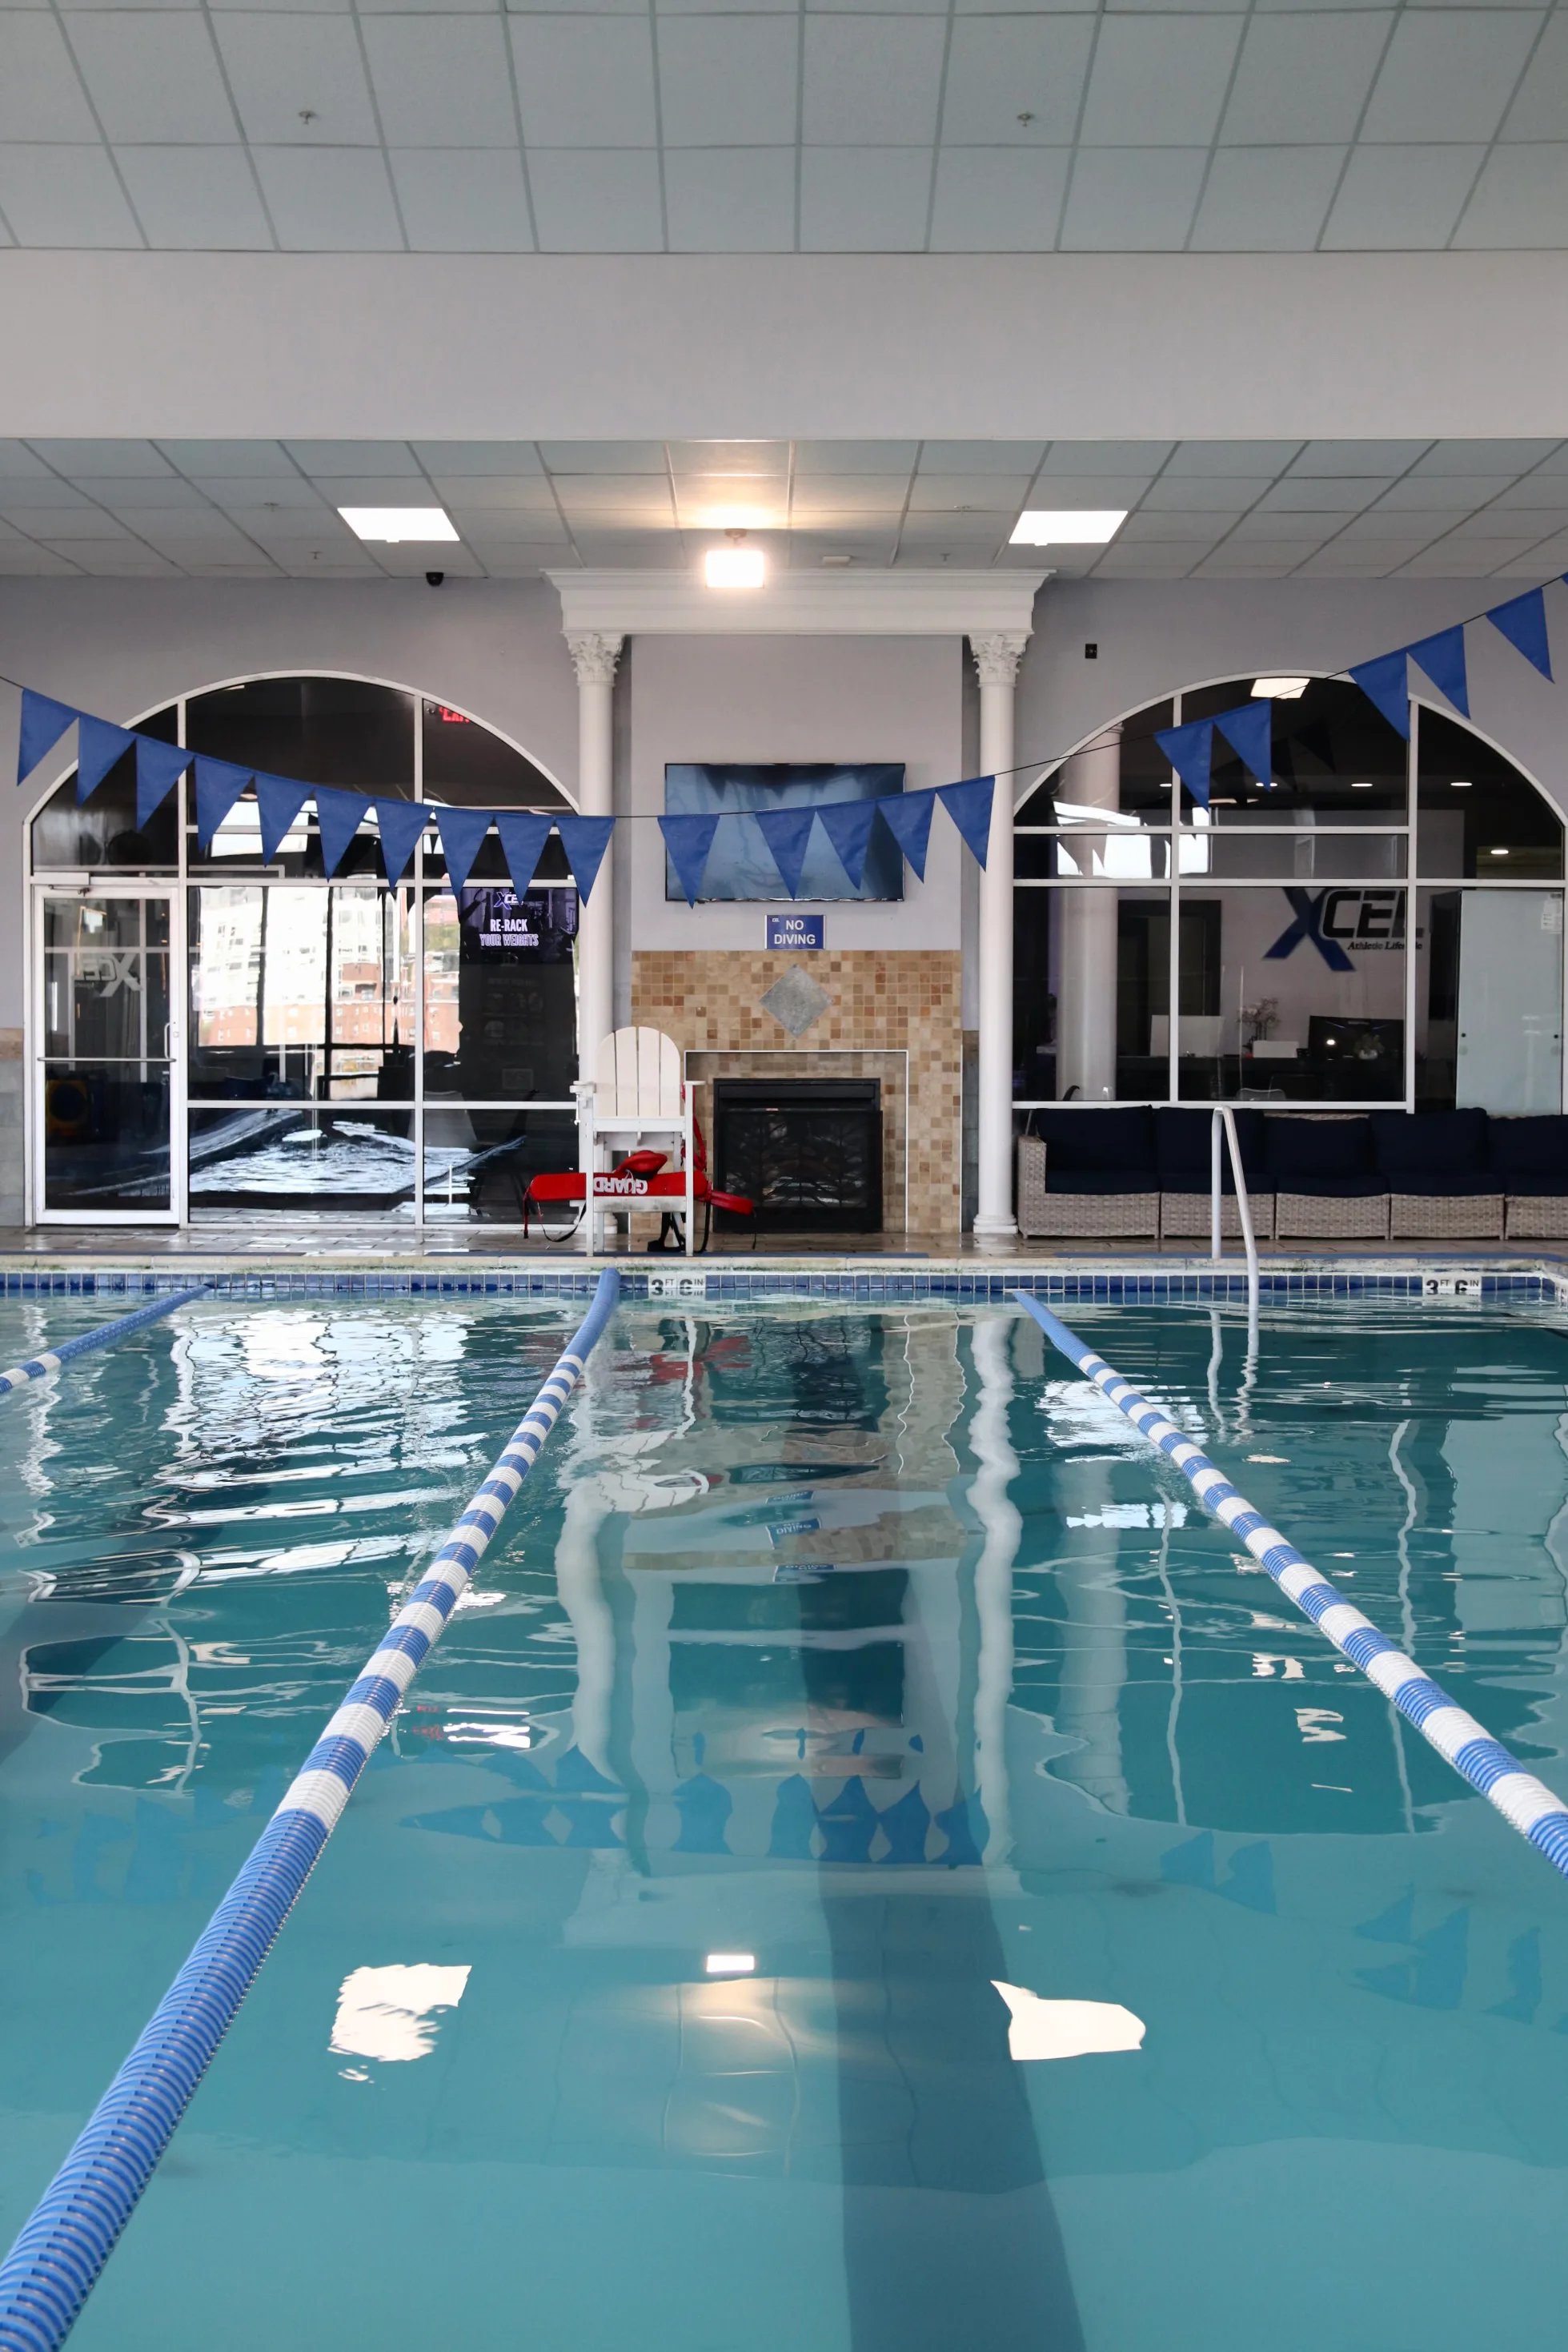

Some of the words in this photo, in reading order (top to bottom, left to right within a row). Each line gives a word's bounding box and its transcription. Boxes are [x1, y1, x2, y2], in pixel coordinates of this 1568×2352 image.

[494, 892, 519, 909] XCE
[490, 918, 528, 932] RE-RACK
[785, 920, 804, 930] NO
[1262, 886, 1424, 971] XCEL
[479, 933, 502, 946] YOUR
[503, 933, 539, 946] WEIGHTS
[774, 933, 816, 945] DIVING
[593, 1176, 648, 1194] GUARD
[651, 1278, 664, 1293] 3
[1426, 1279, 1439, 1292] 3
[1440, 1279, 1450, 1287] FT
[1470, 1279, 1479, 1287] IN
